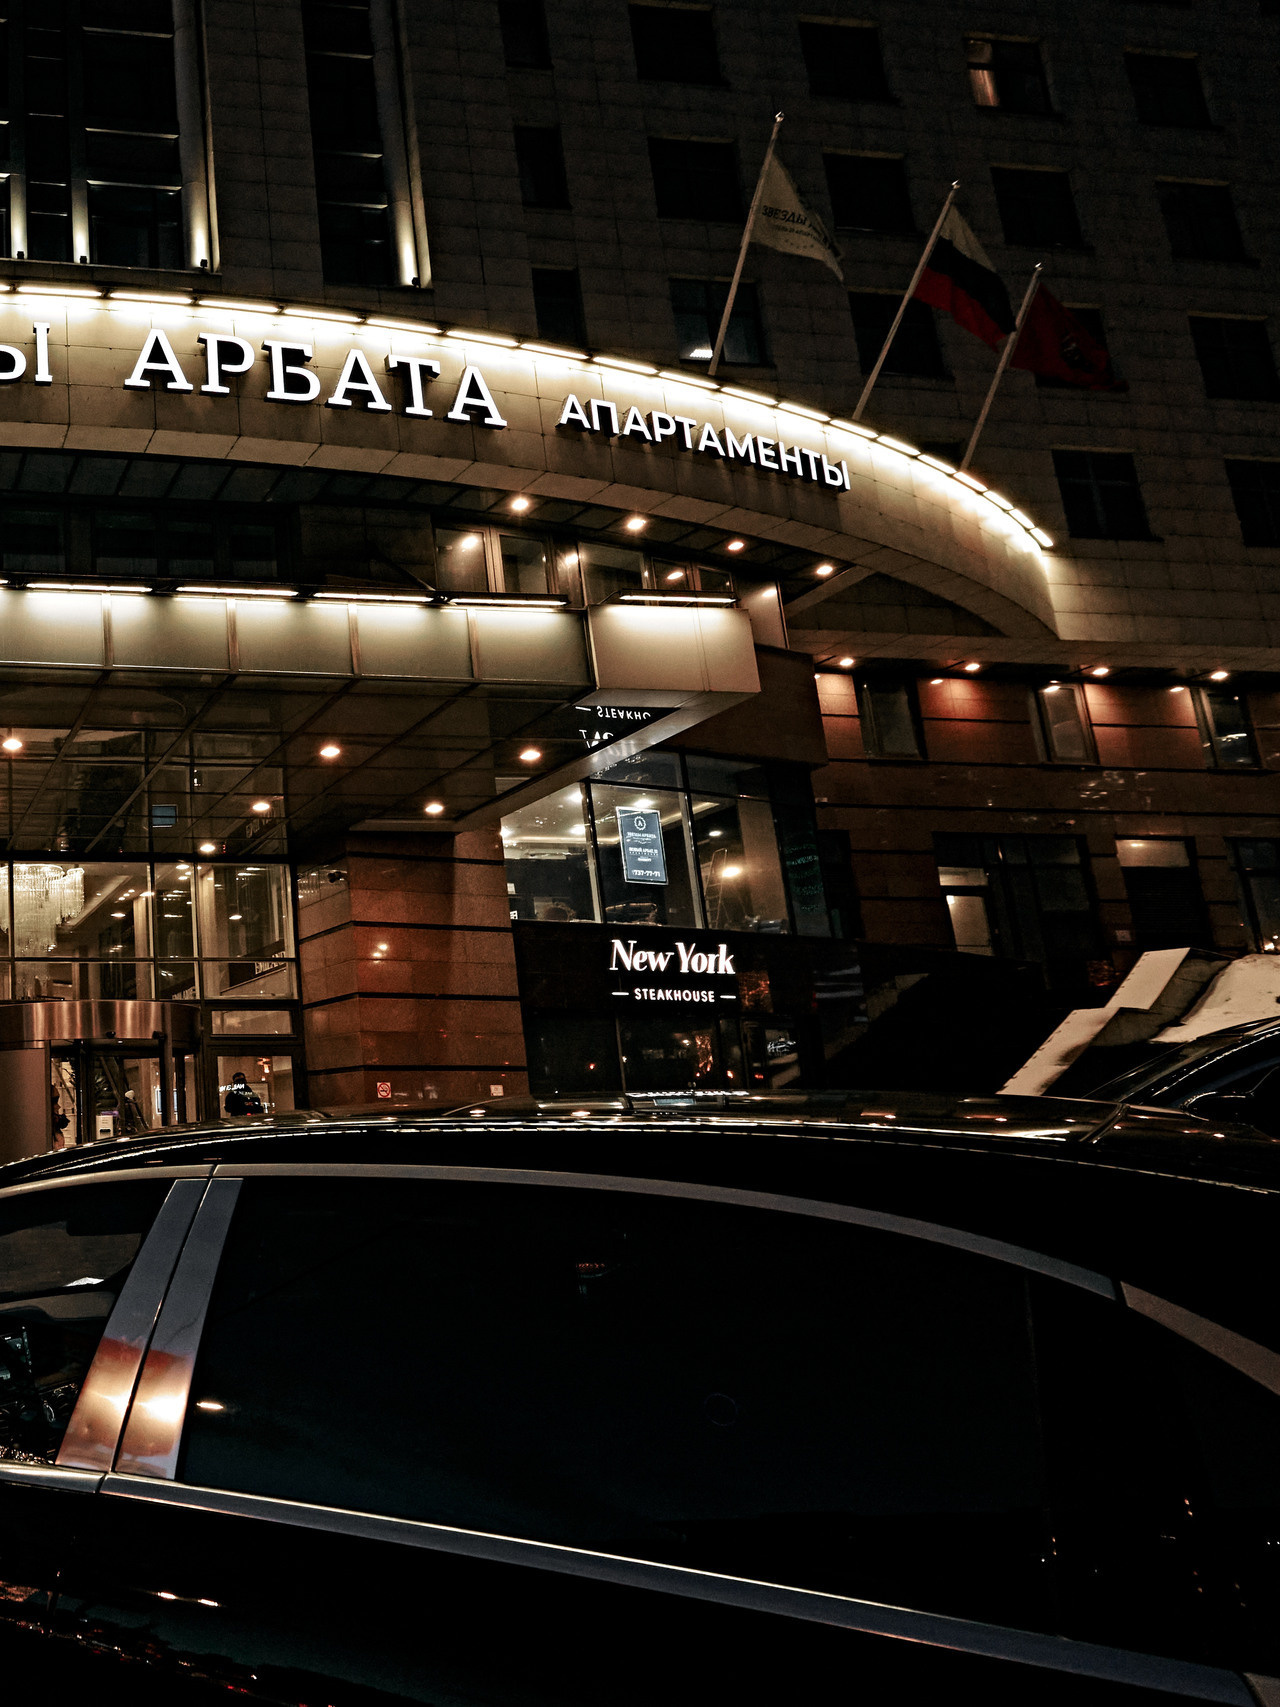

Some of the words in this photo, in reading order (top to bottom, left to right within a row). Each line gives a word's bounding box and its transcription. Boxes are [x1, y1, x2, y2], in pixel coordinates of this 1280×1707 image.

[124, 328, 508, 428] АРБАТА
[558, 393, 851, 491] АПАРТАМЕНТЫ
[609, 939, 675, 971] New
[675, 942, 736, 974] York
[635, 987, 715, 1002] STEAKHOUSE
